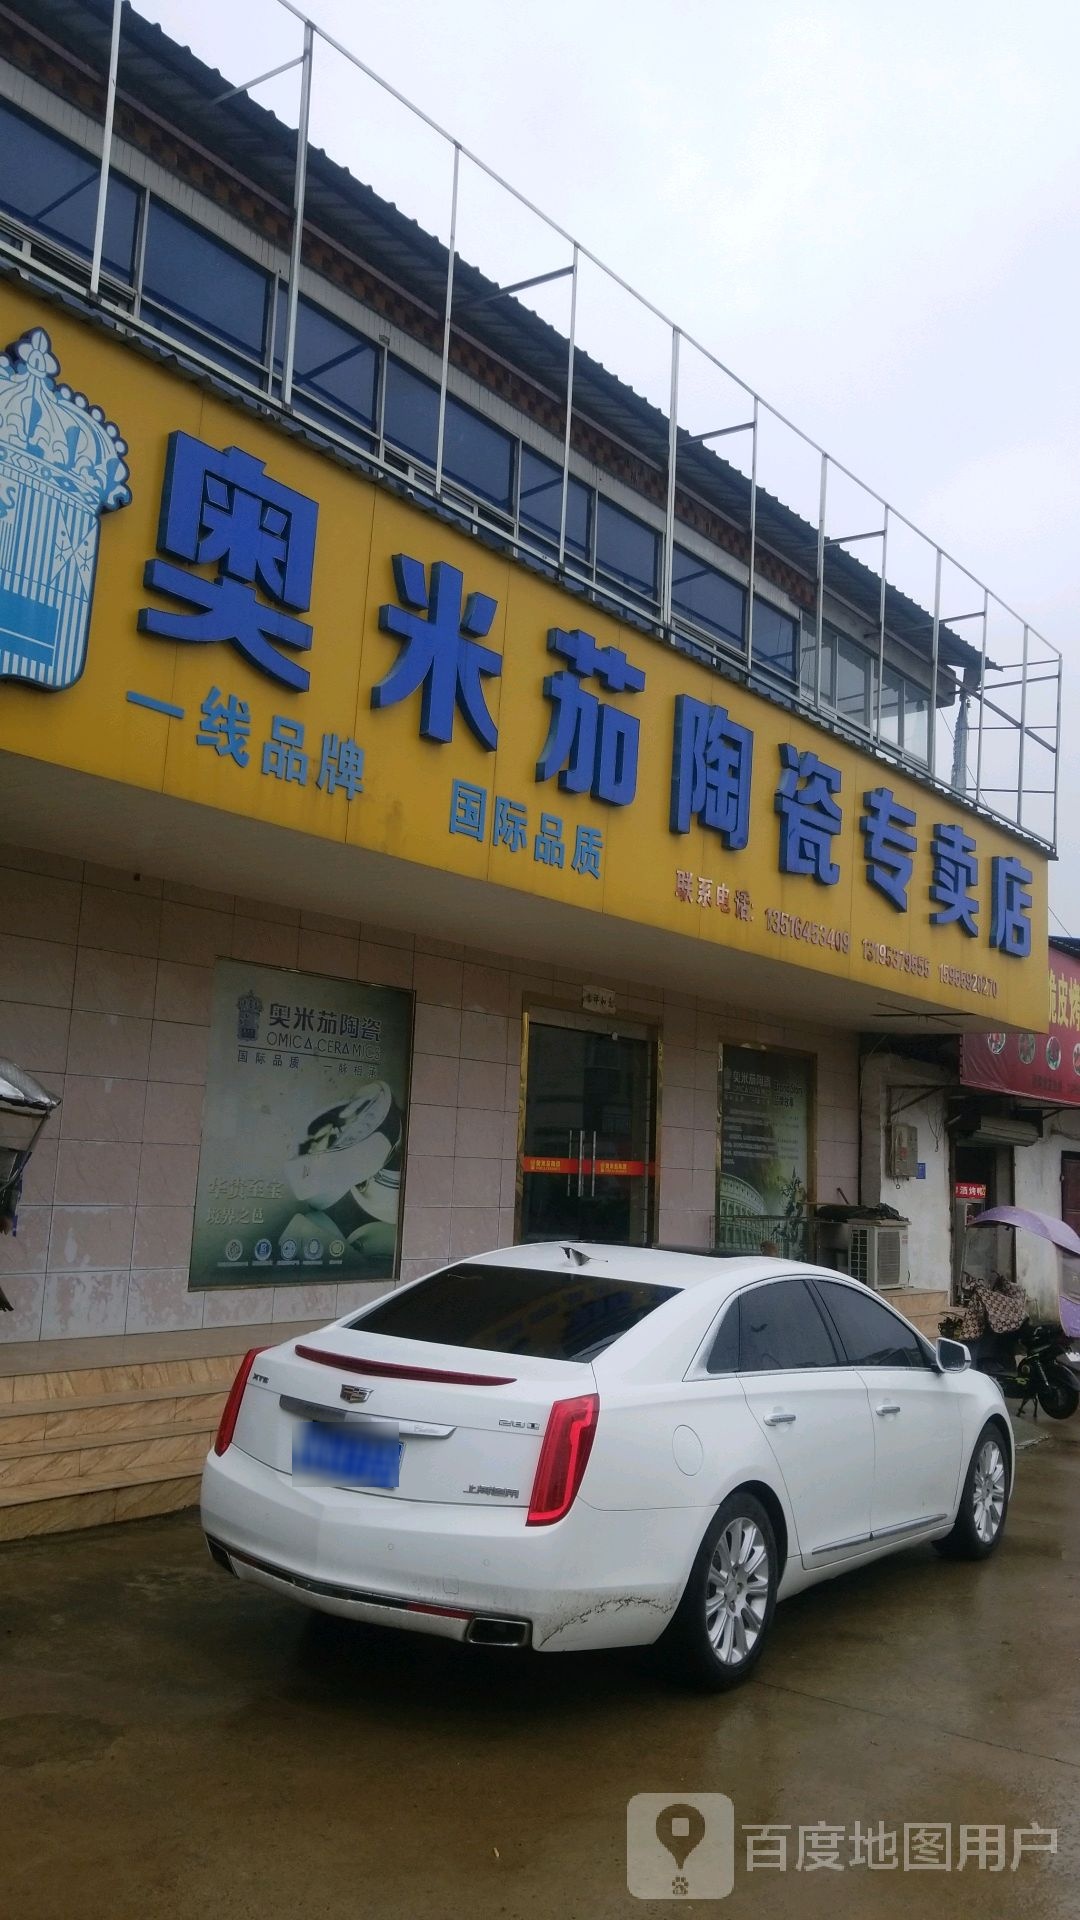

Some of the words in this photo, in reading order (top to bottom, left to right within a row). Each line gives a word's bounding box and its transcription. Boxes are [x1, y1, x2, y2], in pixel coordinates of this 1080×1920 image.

[136, 430, 1032, 958] 奥米茄陶瓷专卖店
[126, 686, 366, 800] 一线品牌
[449, 778, 604, 880] 国际品质
[765, 908, 850, 954] 13516453409
[269, 1003, 382, 1041] 奥米茄陶瓷
[237, 1050, 300, 1069] 国际品质
[955, 1184, 986, 1197] 酒烤鸭
